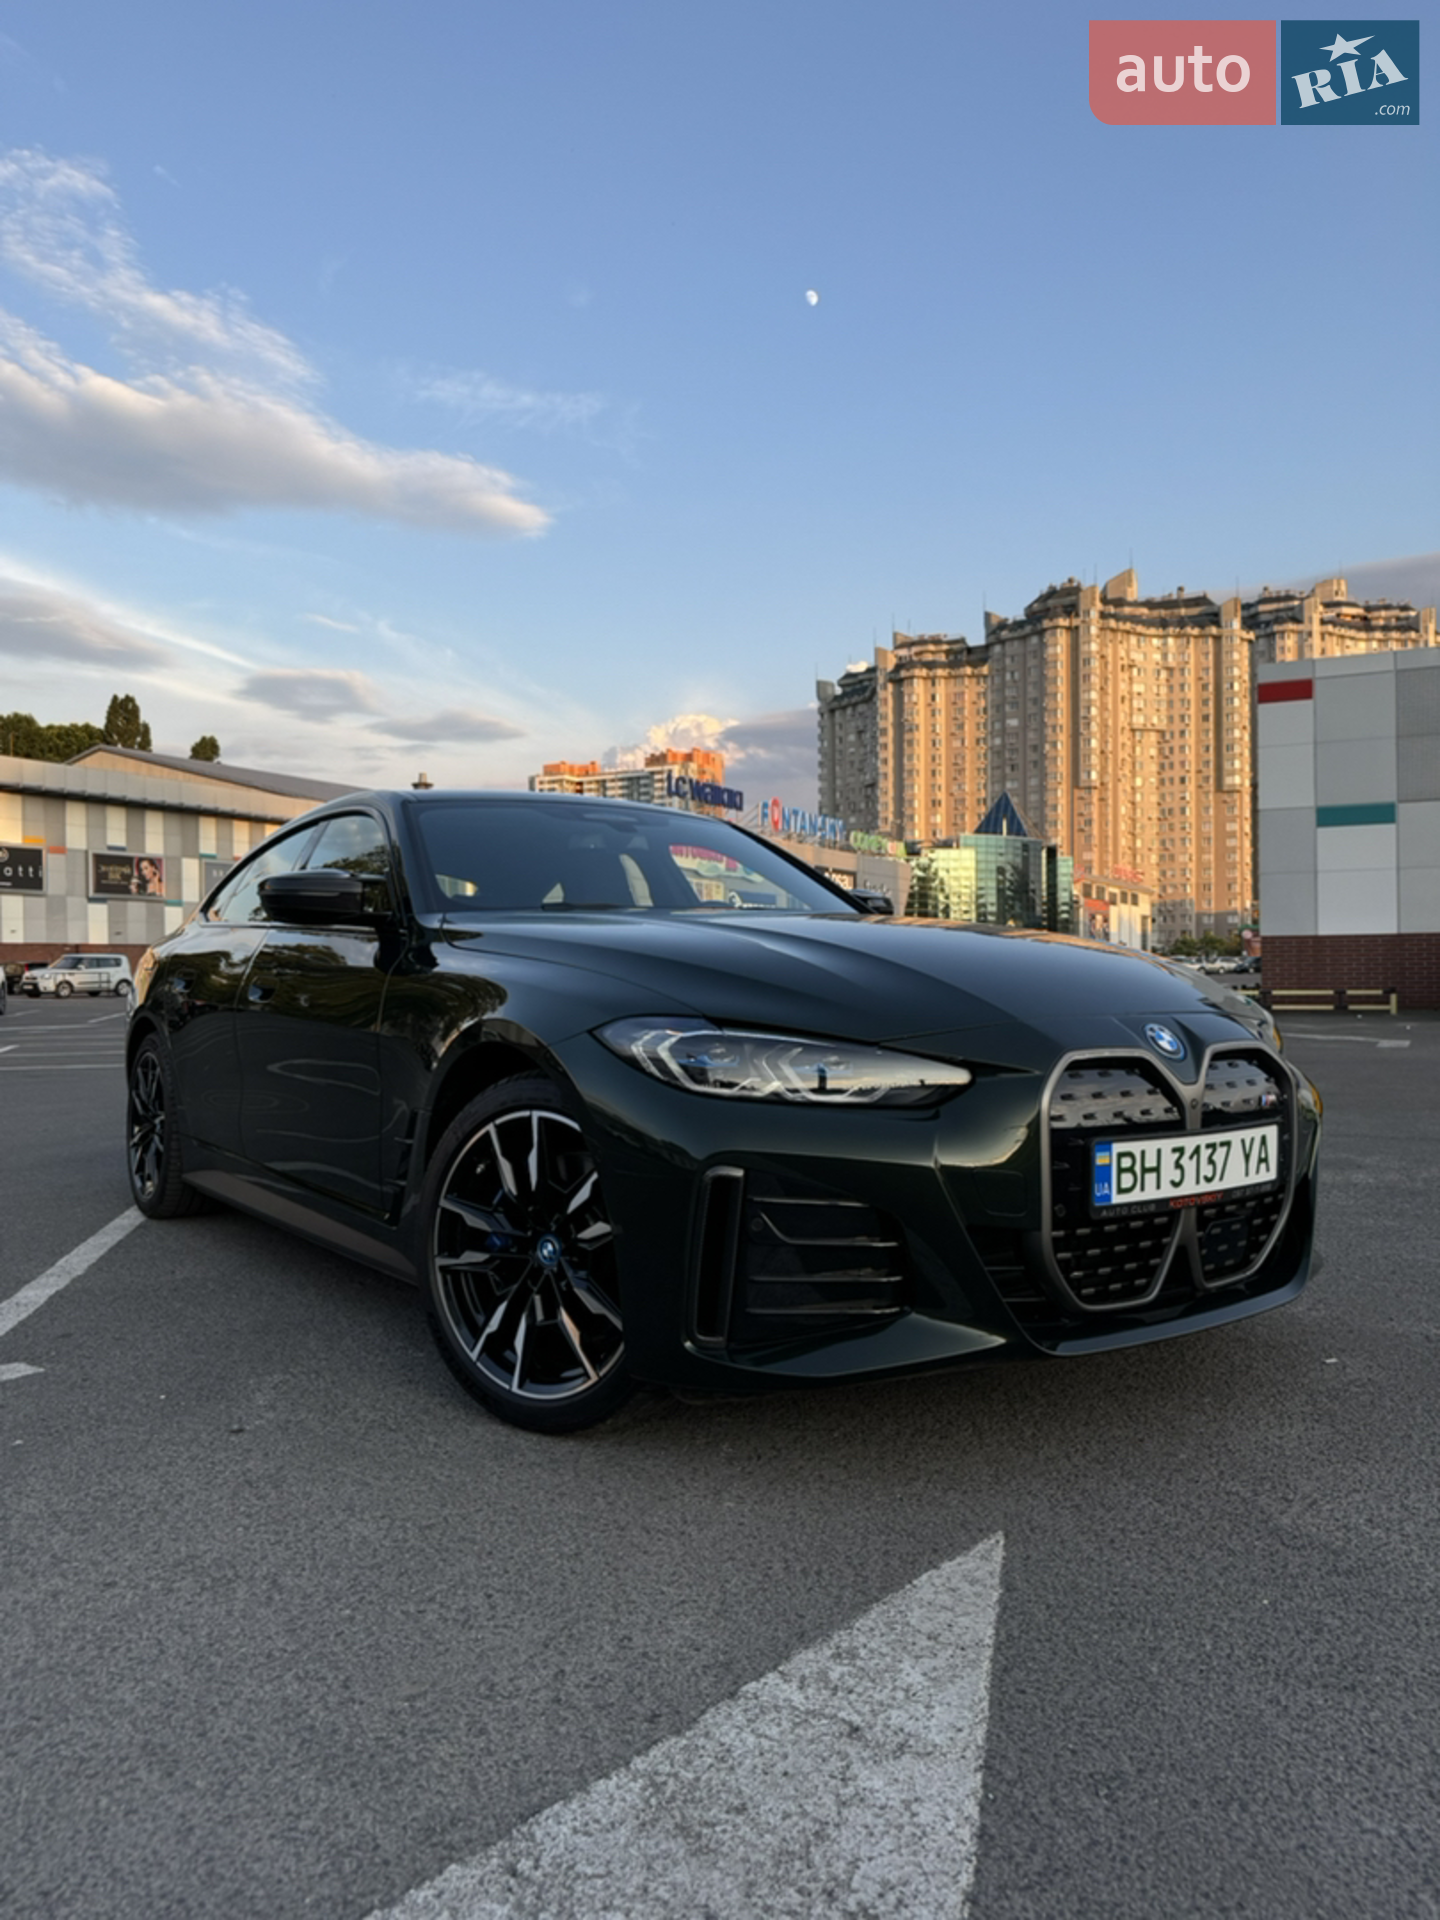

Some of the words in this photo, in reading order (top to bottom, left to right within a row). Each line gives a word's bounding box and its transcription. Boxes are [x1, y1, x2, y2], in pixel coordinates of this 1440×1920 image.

[1116, 1148, 1161, 1195] BH
[1170, 1140, 1232, 1188] 3137
[1241, 1134, 1270, 1177] YA
[1095, 1183, 1111, 1196] UA
[1100, 1206, 1129, 1217] AUTO
[1130, 1203, 1156, 1214] CLUB
